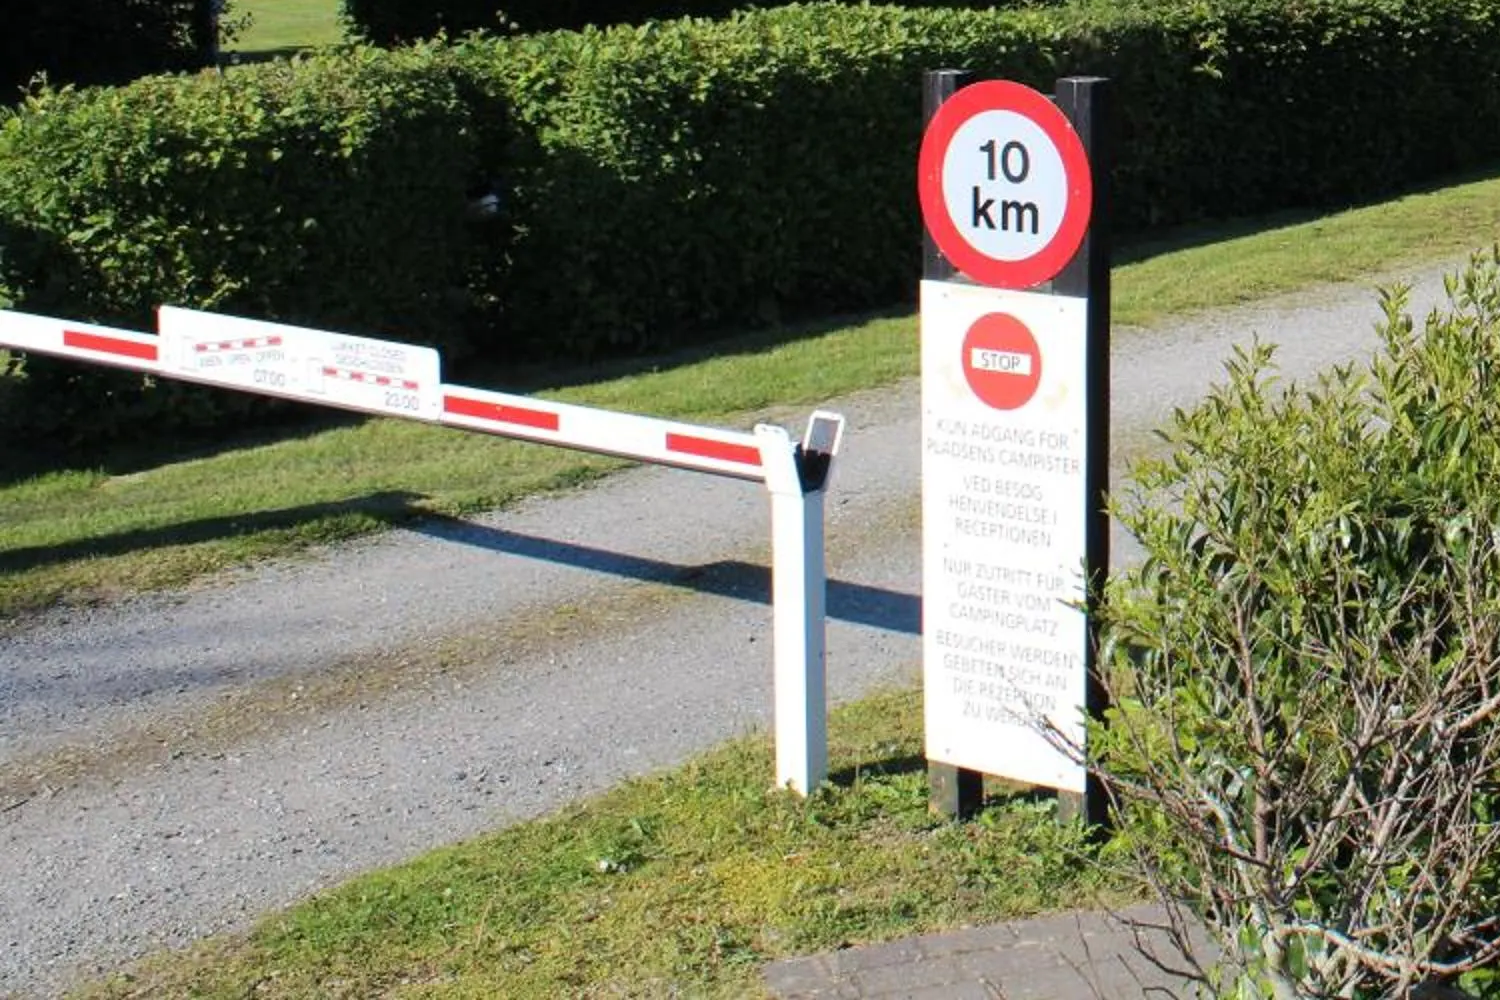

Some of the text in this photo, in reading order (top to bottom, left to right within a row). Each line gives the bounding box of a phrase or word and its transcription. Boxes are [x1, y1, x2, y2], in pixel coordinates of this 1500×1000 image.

[979, 139, 1030, 184] 10
[972, 185, 1039, 235] km
[981, 352, 1021, 371] STOP
[936, 418, 1070, 451] KUN ADGANG FOR
[927, 437, 1080, 475] PLADSENS CAMPISTER
[963, 475, 1044, 502] VED BESØG
[949, 493, 1049, 526] HENVENDELSE
[955, 516, 1051, 548] RECEPTIONEN
[943, 556, 973, 577] NUR
[975, 562, 1032, 587] ZUTRITT
[1014, 593, 1052, 612] VOM
[949, 602, 1059, 638] CAMPINGPLATZ
[936, 629, 1075, 670] BESUCHER WERDEN
[943, 652, 1067, 691] GEBETEN SICH AN
[953, 676, 1056, 711] DIE REZEPTION
[963, 700, 981, 718] ZU
